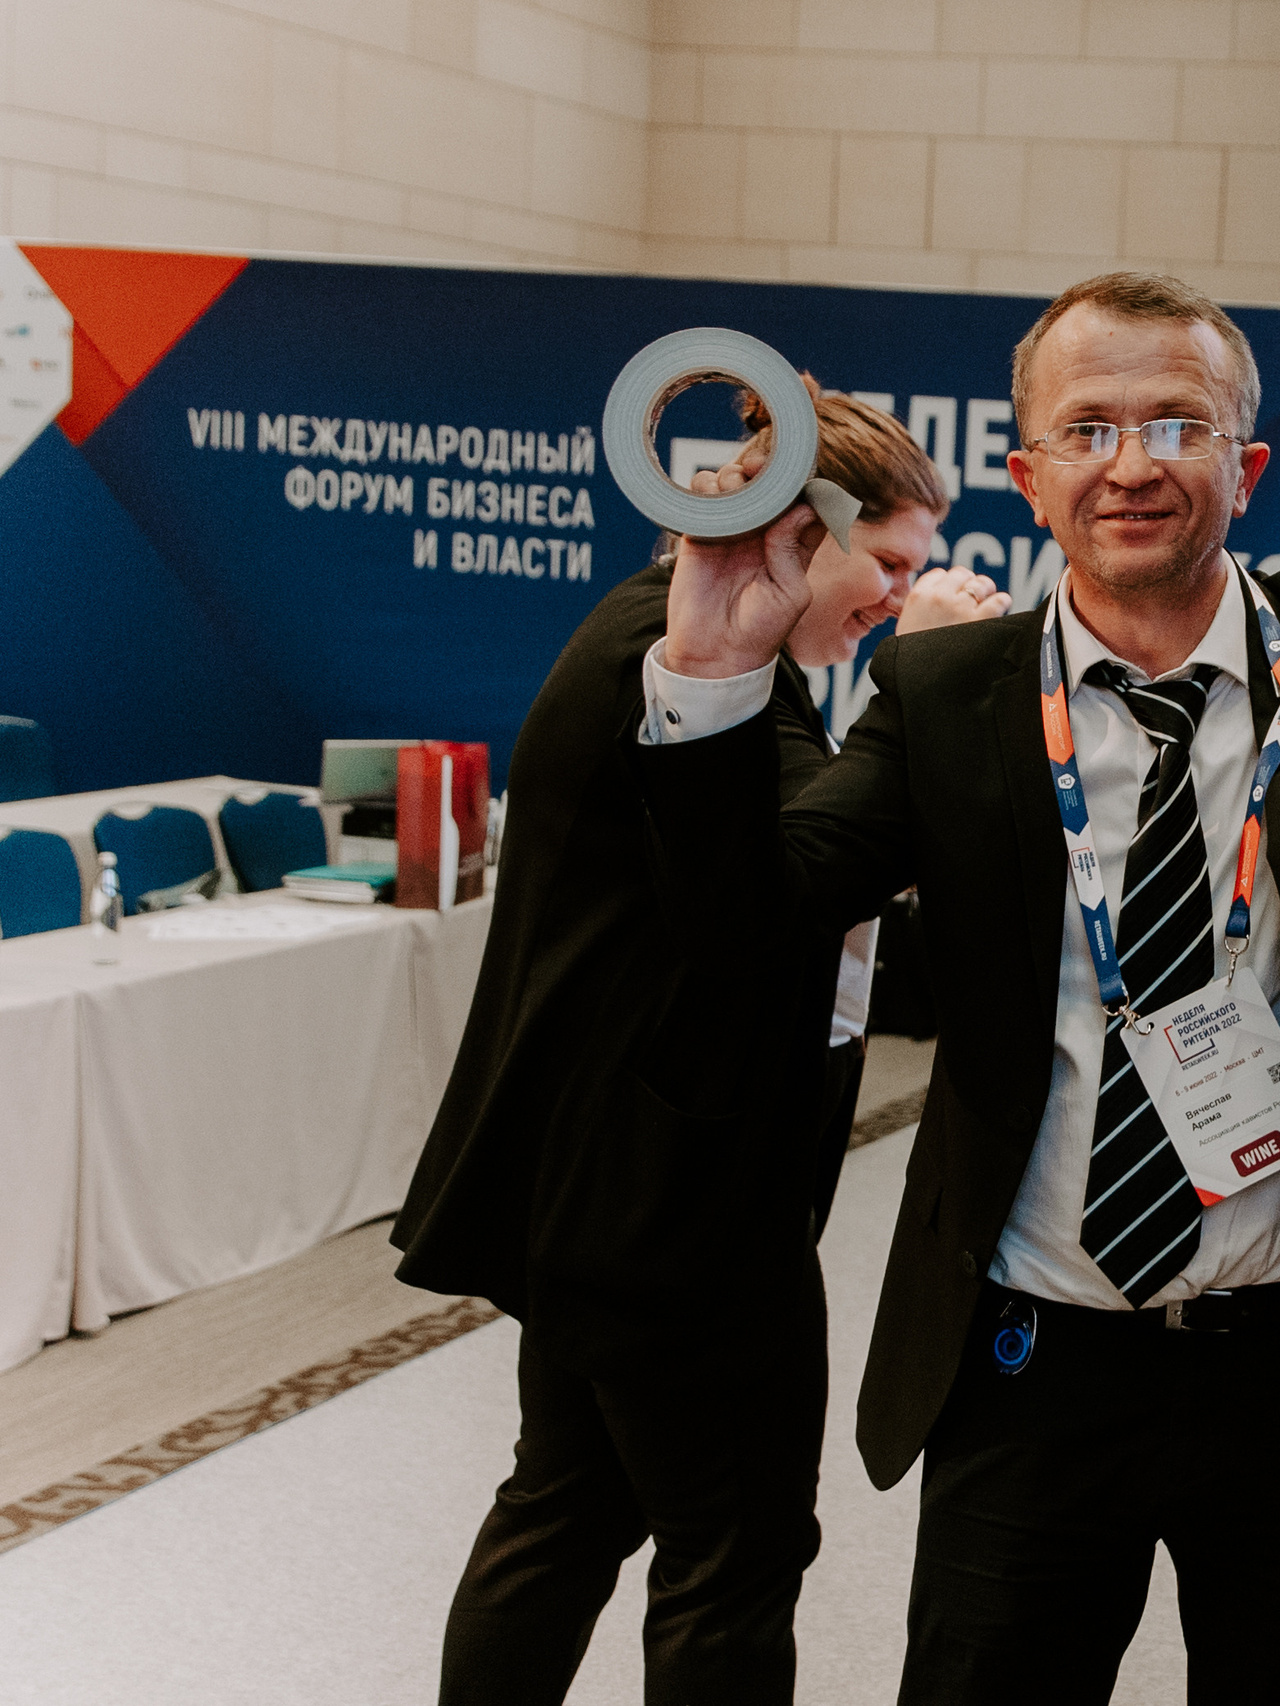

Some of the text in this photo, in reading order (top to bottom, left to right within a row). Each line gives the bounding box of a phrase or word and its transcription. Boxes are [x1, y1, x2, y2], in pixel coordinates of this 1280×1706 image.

[187, 407, 596, 476] VIII МЕЖДУНАРОДНЫЙ
[284, 464, 596, 530] ФОРУМ БИЗНЕСА
[413, 528, 592, 583] И ВЛАСТИ
[1172, 1003, 1206, 1026] НЕДЕЛЯ
[1177, 1002, 1237, 1037] РОССИЙСКОГО
[1183, 1013, 1242, 1048] РИТЕЙЛА 2022
[1181, 1048, 1219, 1071] RETAILWEEK.RU
[1189, 1079, 1204, 1090] июня
[1204, 1071, 1218, 1083] 2022
[1223, 1058, 1246, 1073] Москва
[1251, 1047, 1265, 1059] ЦМТ
[1185, 1093, 1232, 1120] Вячеслав
[1192, 1111, 1222, 1132] Арама
[1199, 1122, 1241, 1147] Ассоциация
[1241, 1106, 1273, 1125] кавистов
[1239, 1138, 1280, 1169] WINE
